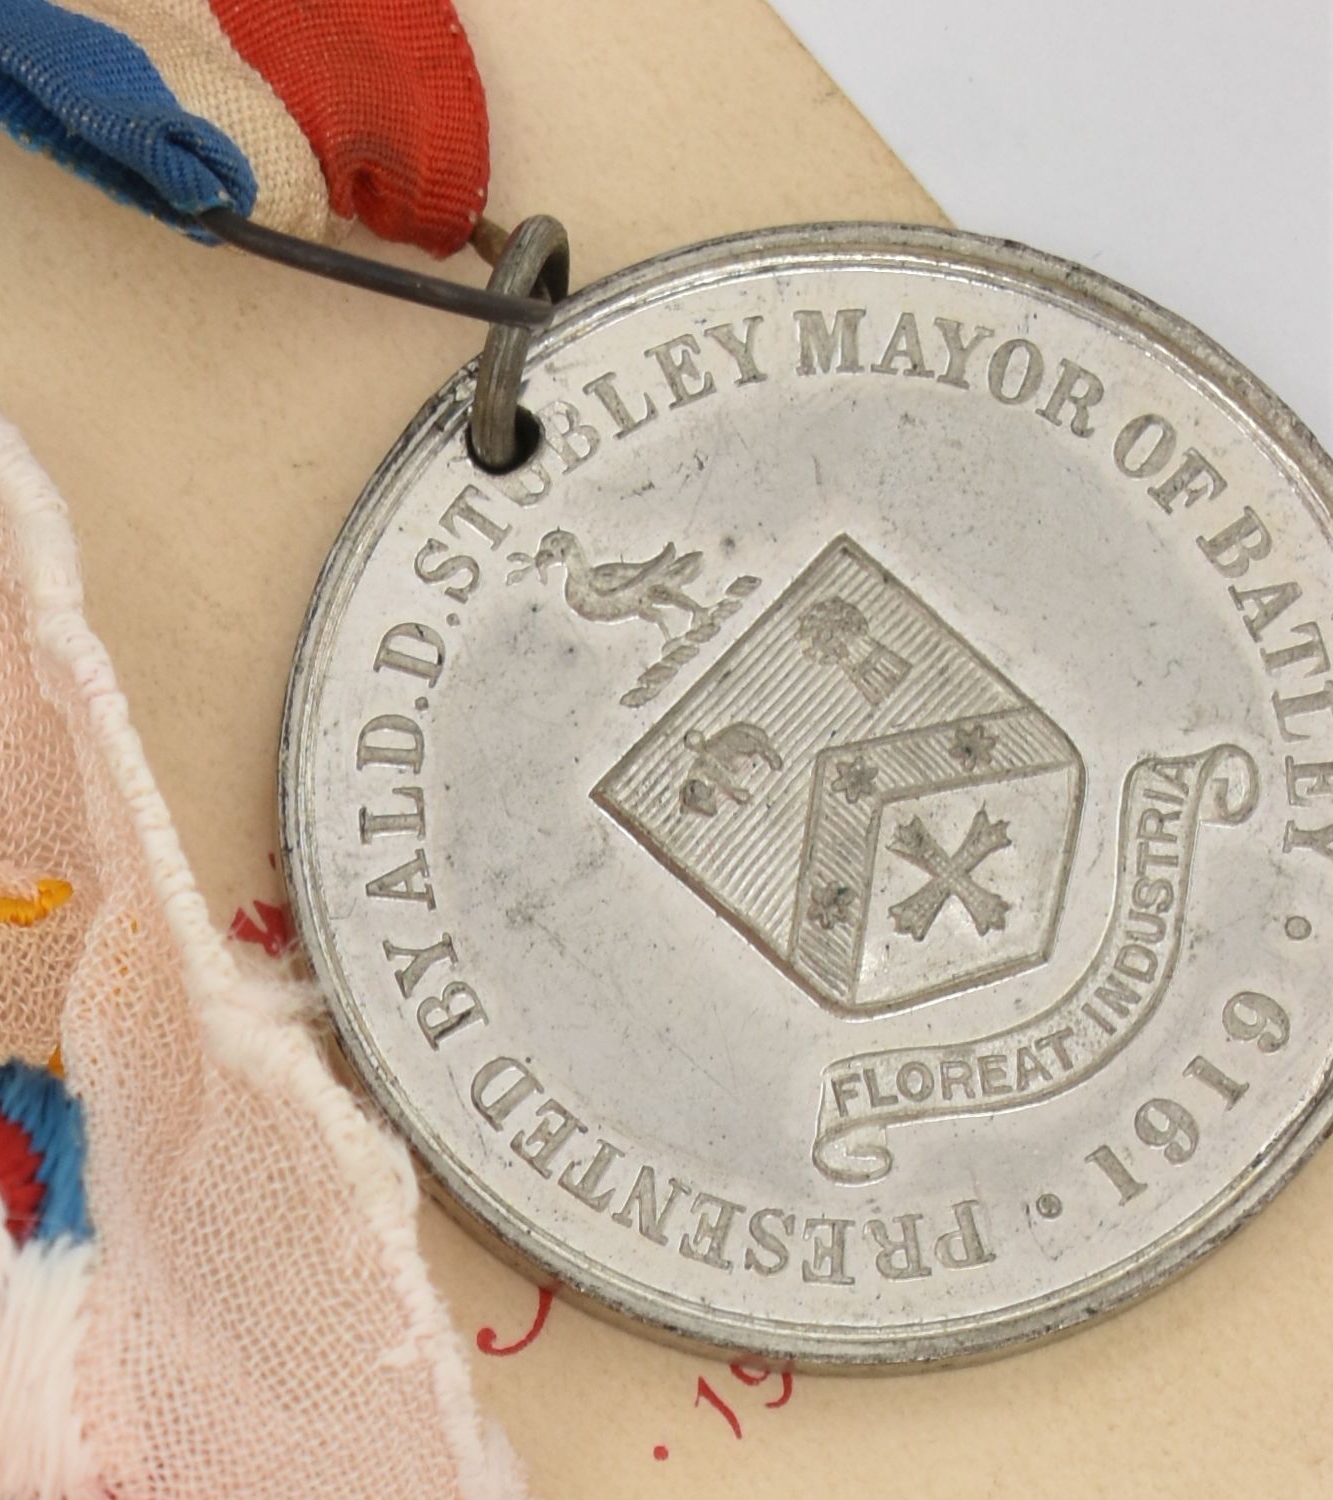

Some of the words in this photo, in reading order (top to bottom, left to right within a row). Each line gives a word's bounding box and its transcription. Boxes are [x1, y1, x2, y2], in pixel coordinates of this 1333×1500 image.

[792, 306, 1105, 440] MAYOR
[1111, 411, 1227, 516] OF
[1195, 504, 1333, 855] BATLEY
[383, 931, 489, 1051] BY
[830, 1027, 1074, 1116] FLOREAT
[1081, 757, 1197, 1037] INDUSTRIA
[469, 1055, 996, 1287] PRESENTED
